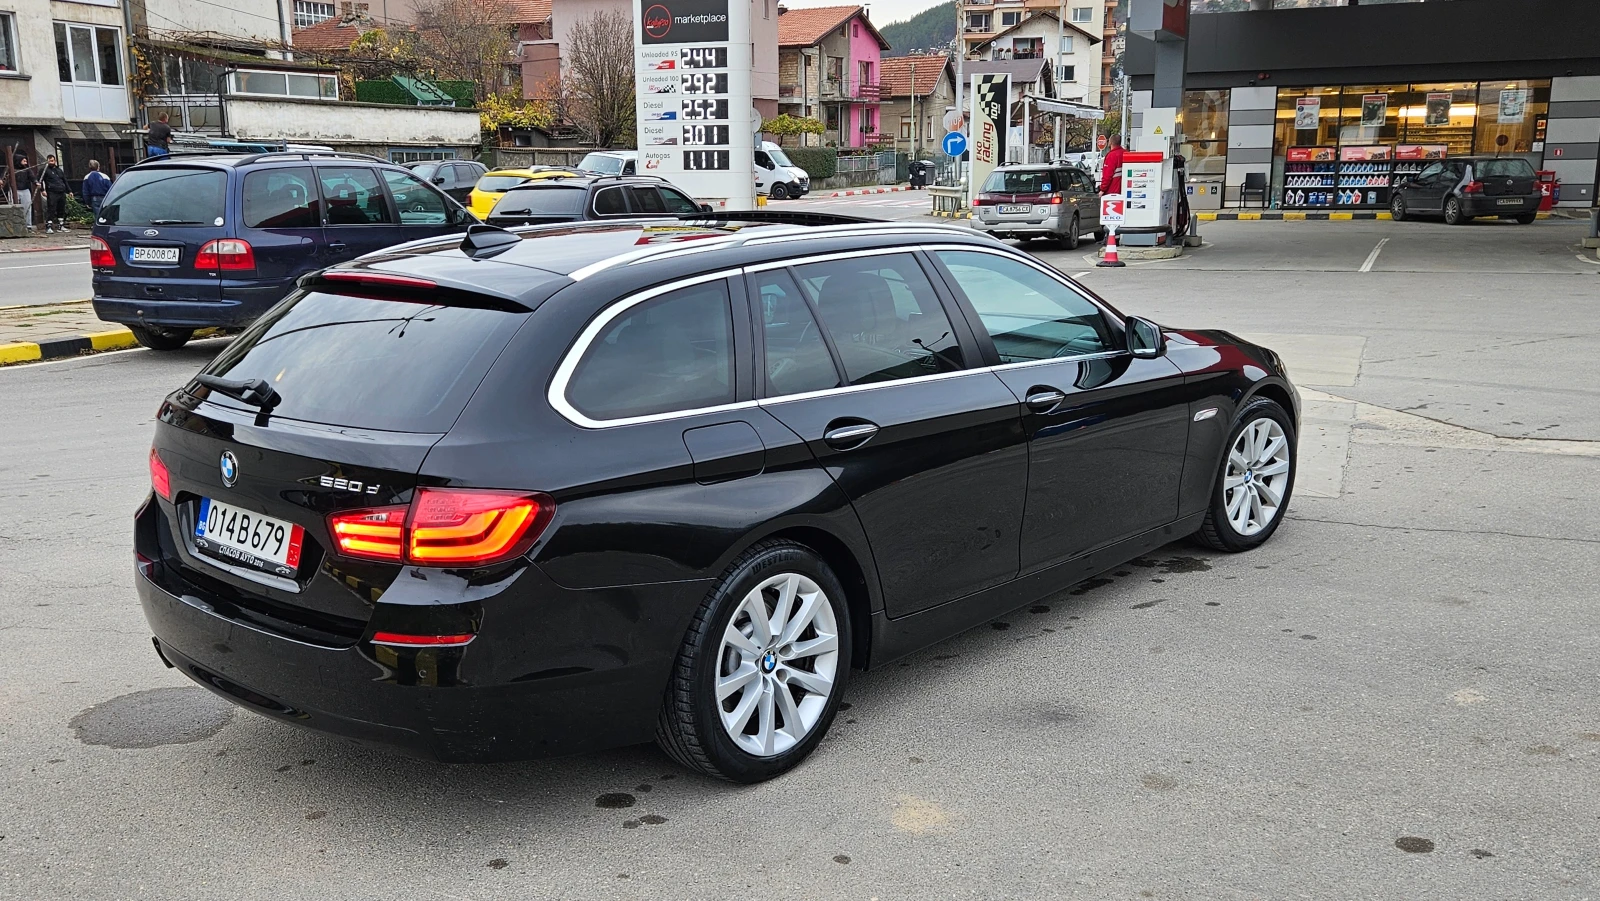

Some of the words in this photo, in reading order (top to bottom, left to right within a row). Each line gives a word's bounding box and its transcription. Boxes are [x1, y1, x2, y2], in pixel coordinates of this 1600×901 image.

[674, 13, 727, 24] marketplace
[681, 48, 716, 69] 2.44
[681, 73, 717, 94] 2.92
[643, 101, 663, 109] Diesel
[682, 99, 717, 120] 2.52
[990, 102, 998, 119] 100
[644, 126, 664, 134] Diesel
[683, 125, 718, 145] 3.01
[982, 122, 994, 164] racing
[645, 152, 671, 160] Autogas
[689, 151, 718, 170] 1.11
[320, 476, 363, 493] 520
[365, 484, 380, 495] d
[198, 520, 206, 531] BG
[208, 505, 285, 556] 014B679
[219, 545, 240, 559] СПАСОВ
